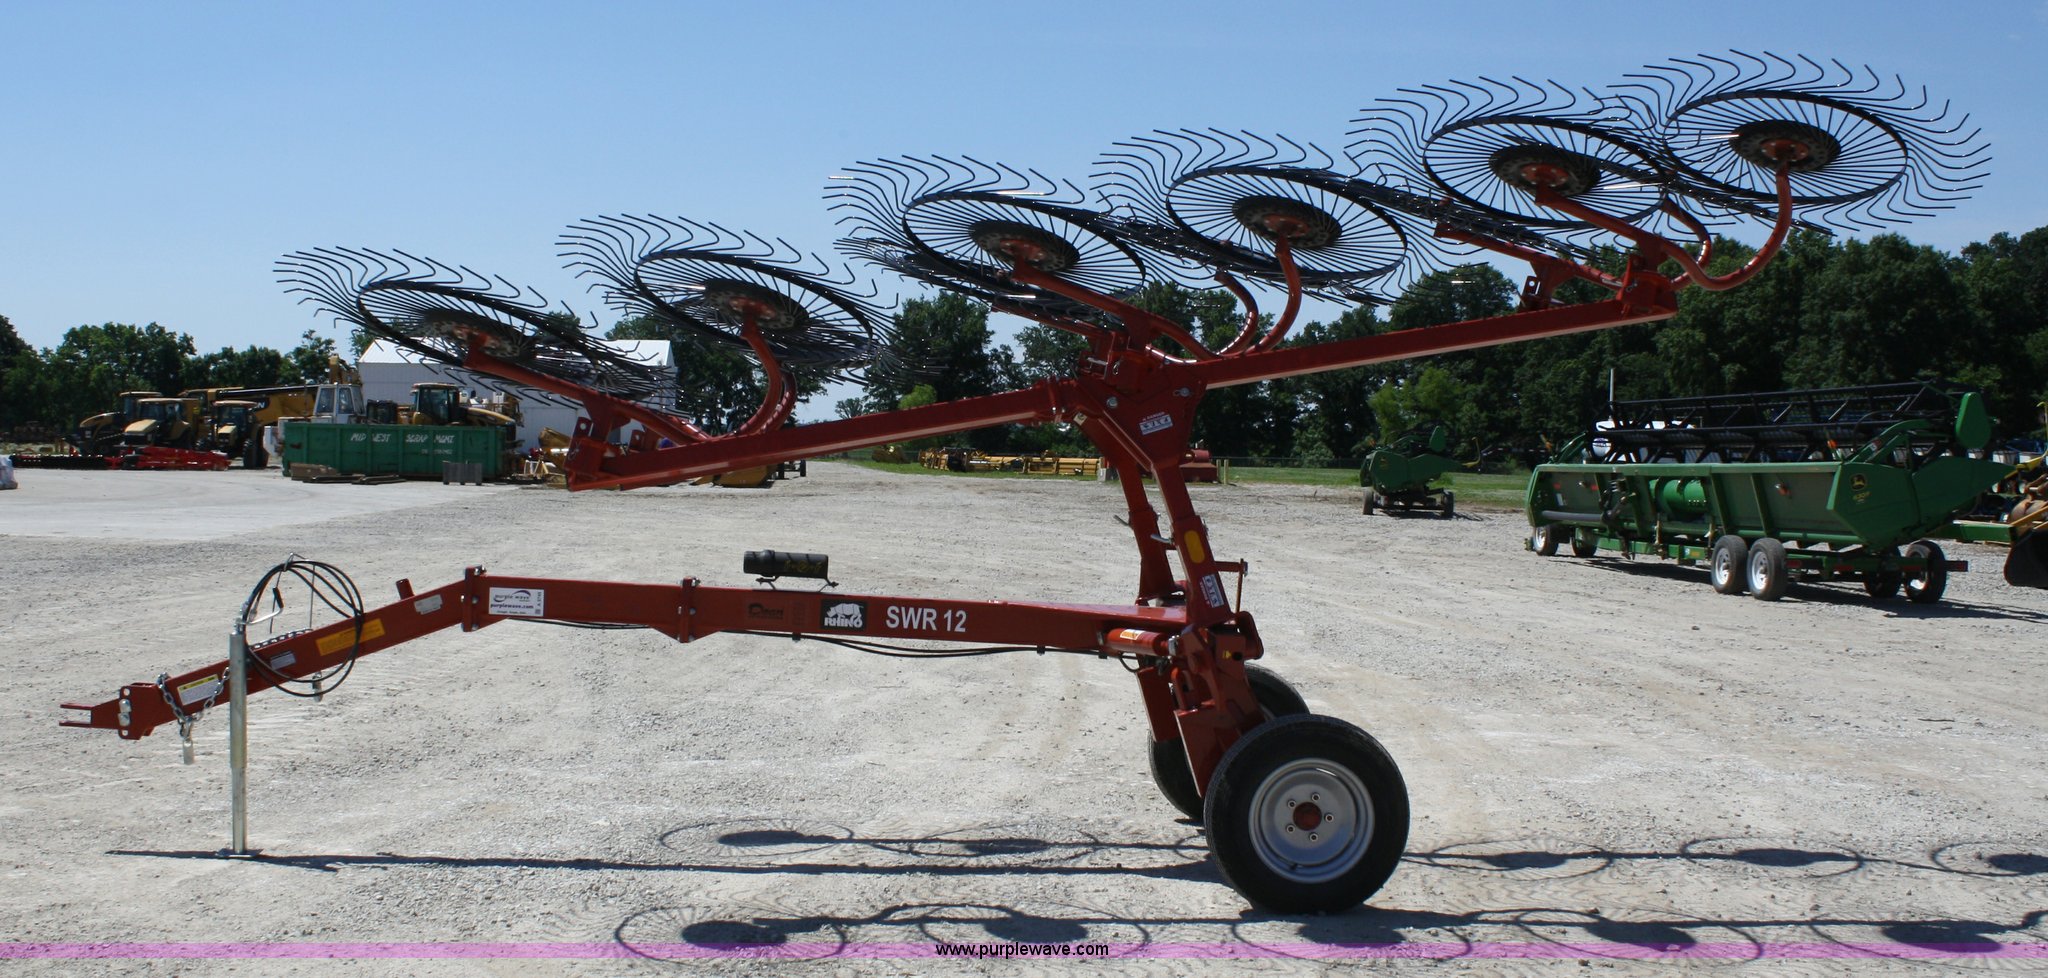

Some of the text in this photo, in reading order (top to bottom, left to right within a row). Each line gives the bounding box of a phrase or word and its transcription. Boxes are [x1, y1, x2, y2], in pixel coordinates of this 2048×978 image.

[824, 617, 864, 629] RHINO
[886, 605, 967, 632] SWR 12
